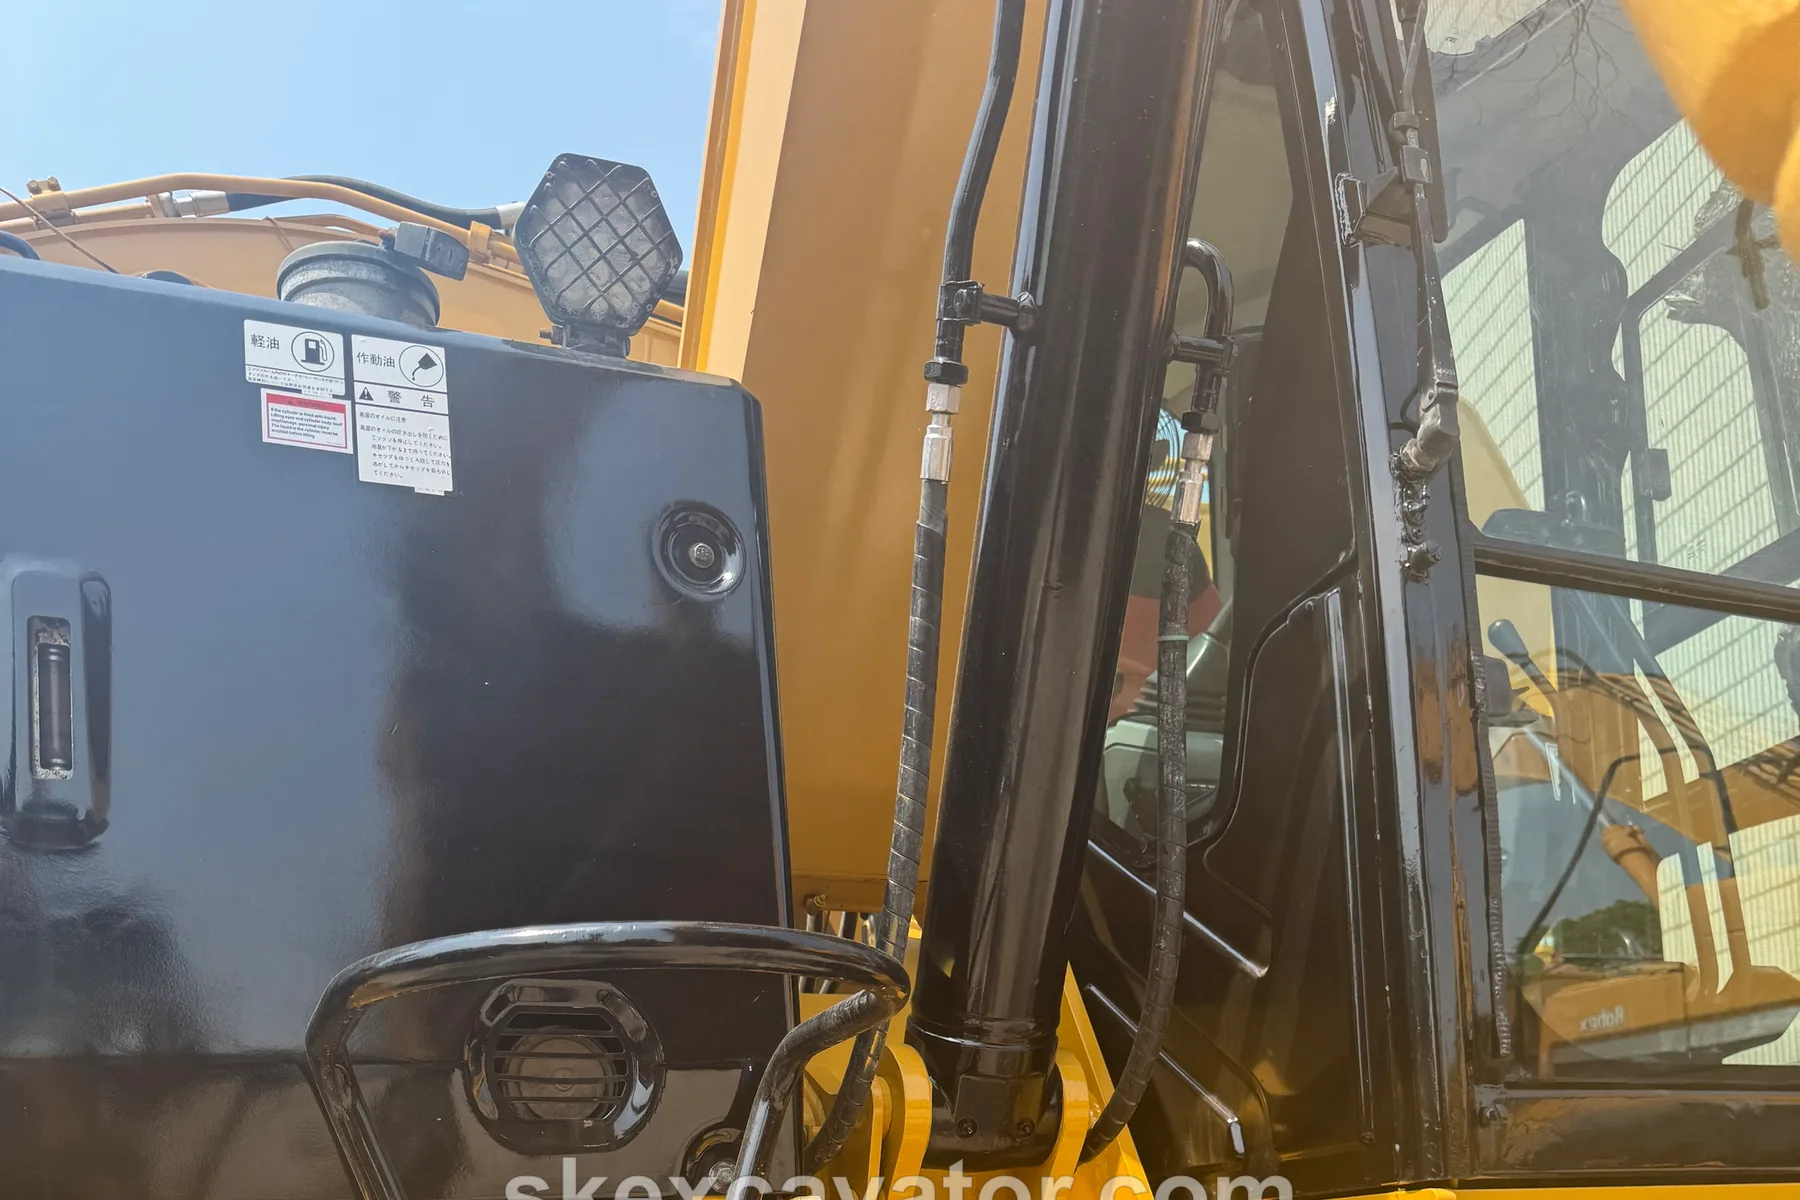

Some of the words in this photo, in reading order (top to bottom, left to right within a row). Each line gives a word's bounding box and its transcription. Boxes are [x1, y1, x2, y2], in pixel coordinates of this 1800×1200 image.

[251, 333, 280, 350] 軽油
[356, 351, 396, 368] 作動油
